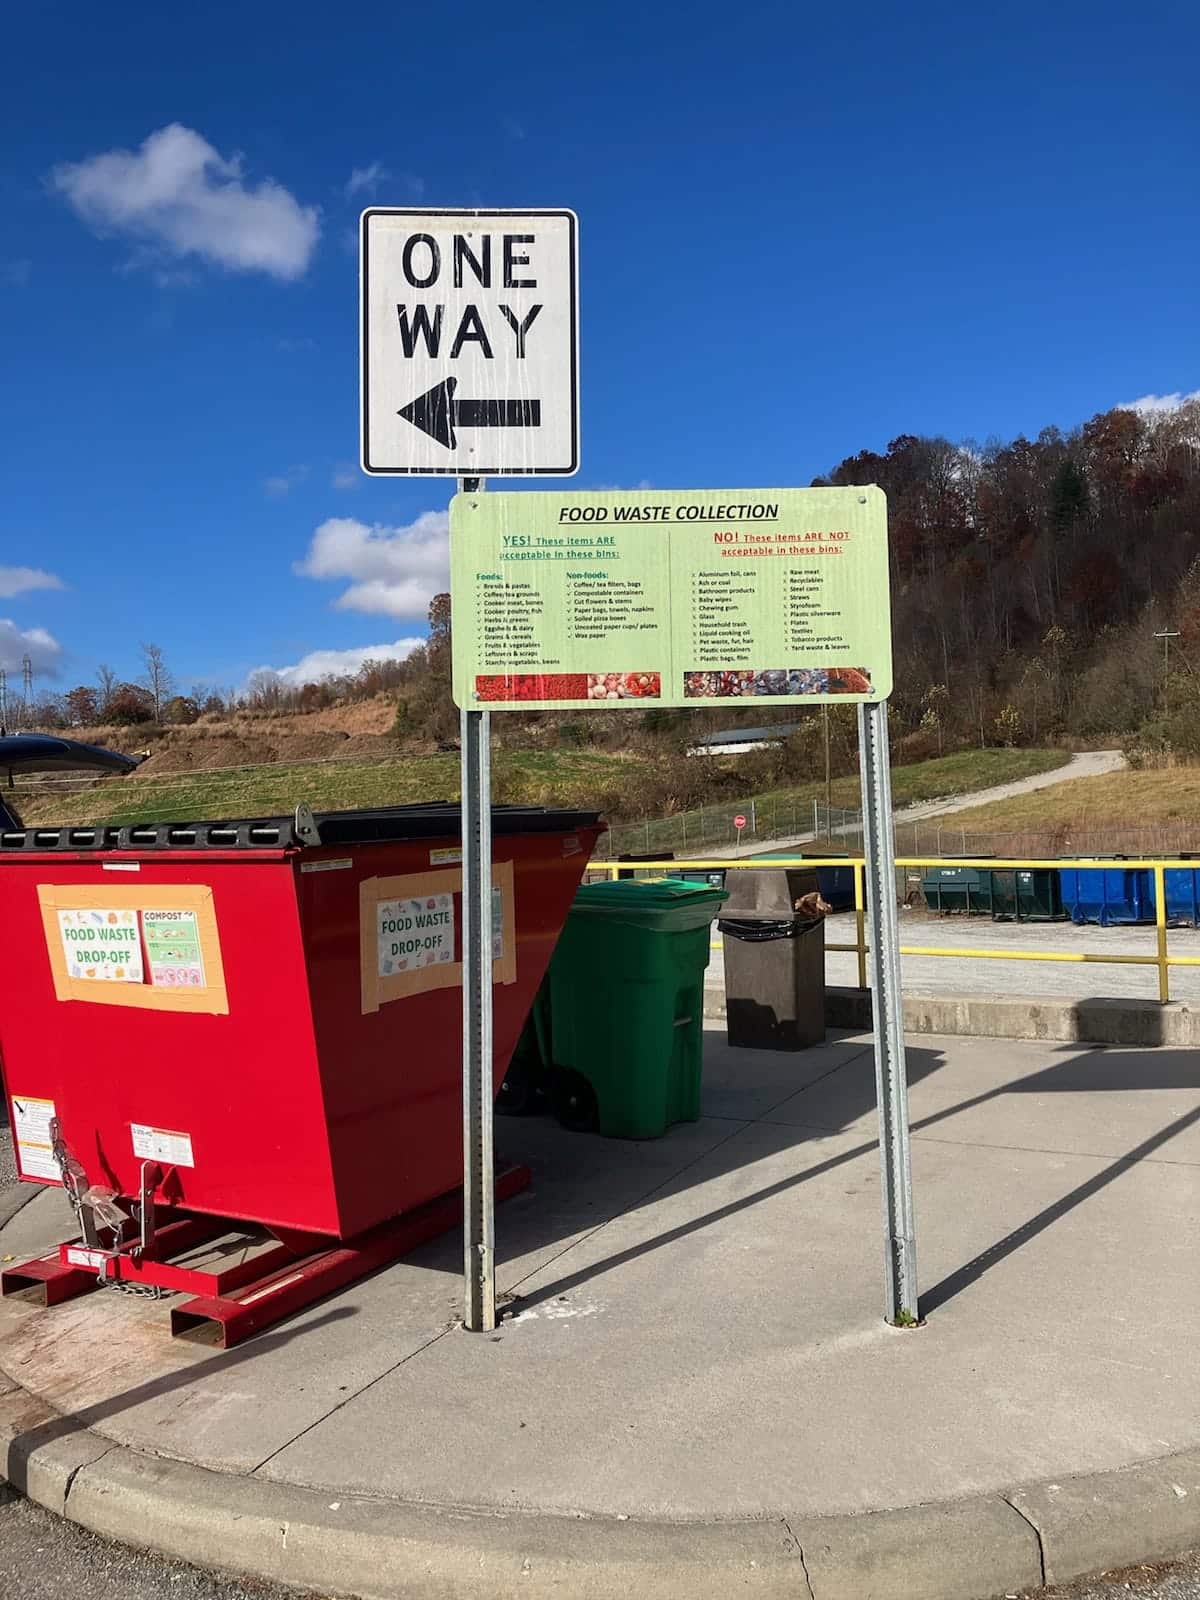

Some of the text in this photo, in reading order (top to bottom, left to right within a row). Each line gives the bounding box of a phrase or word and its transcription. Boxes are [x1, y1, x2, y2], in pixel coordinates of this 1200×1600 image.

[402, 233, 537, 288] ONE
[397, 304, 543, 359] WAY
[559, 504, 778, 521] FOOD WASTE COLLECTION
[503, 536, 531, 546] YES!
[537, 537, 563, 545] These
[714, 532, 738, 542] NO!
[566, 550, 592, 558] these
[722, 547, 773, 556] acceptable
[819, 545, 842, 553] bins:
[144, 912, 182, 921] COMPOST
[382, 912, 450, 934] FOOD WASTE
[64, 928, 136, 941] FOOD WASTE
[391, 935, 442, 955] DROP-OFF
[77, 950, 131, 962] DROP-OFF
